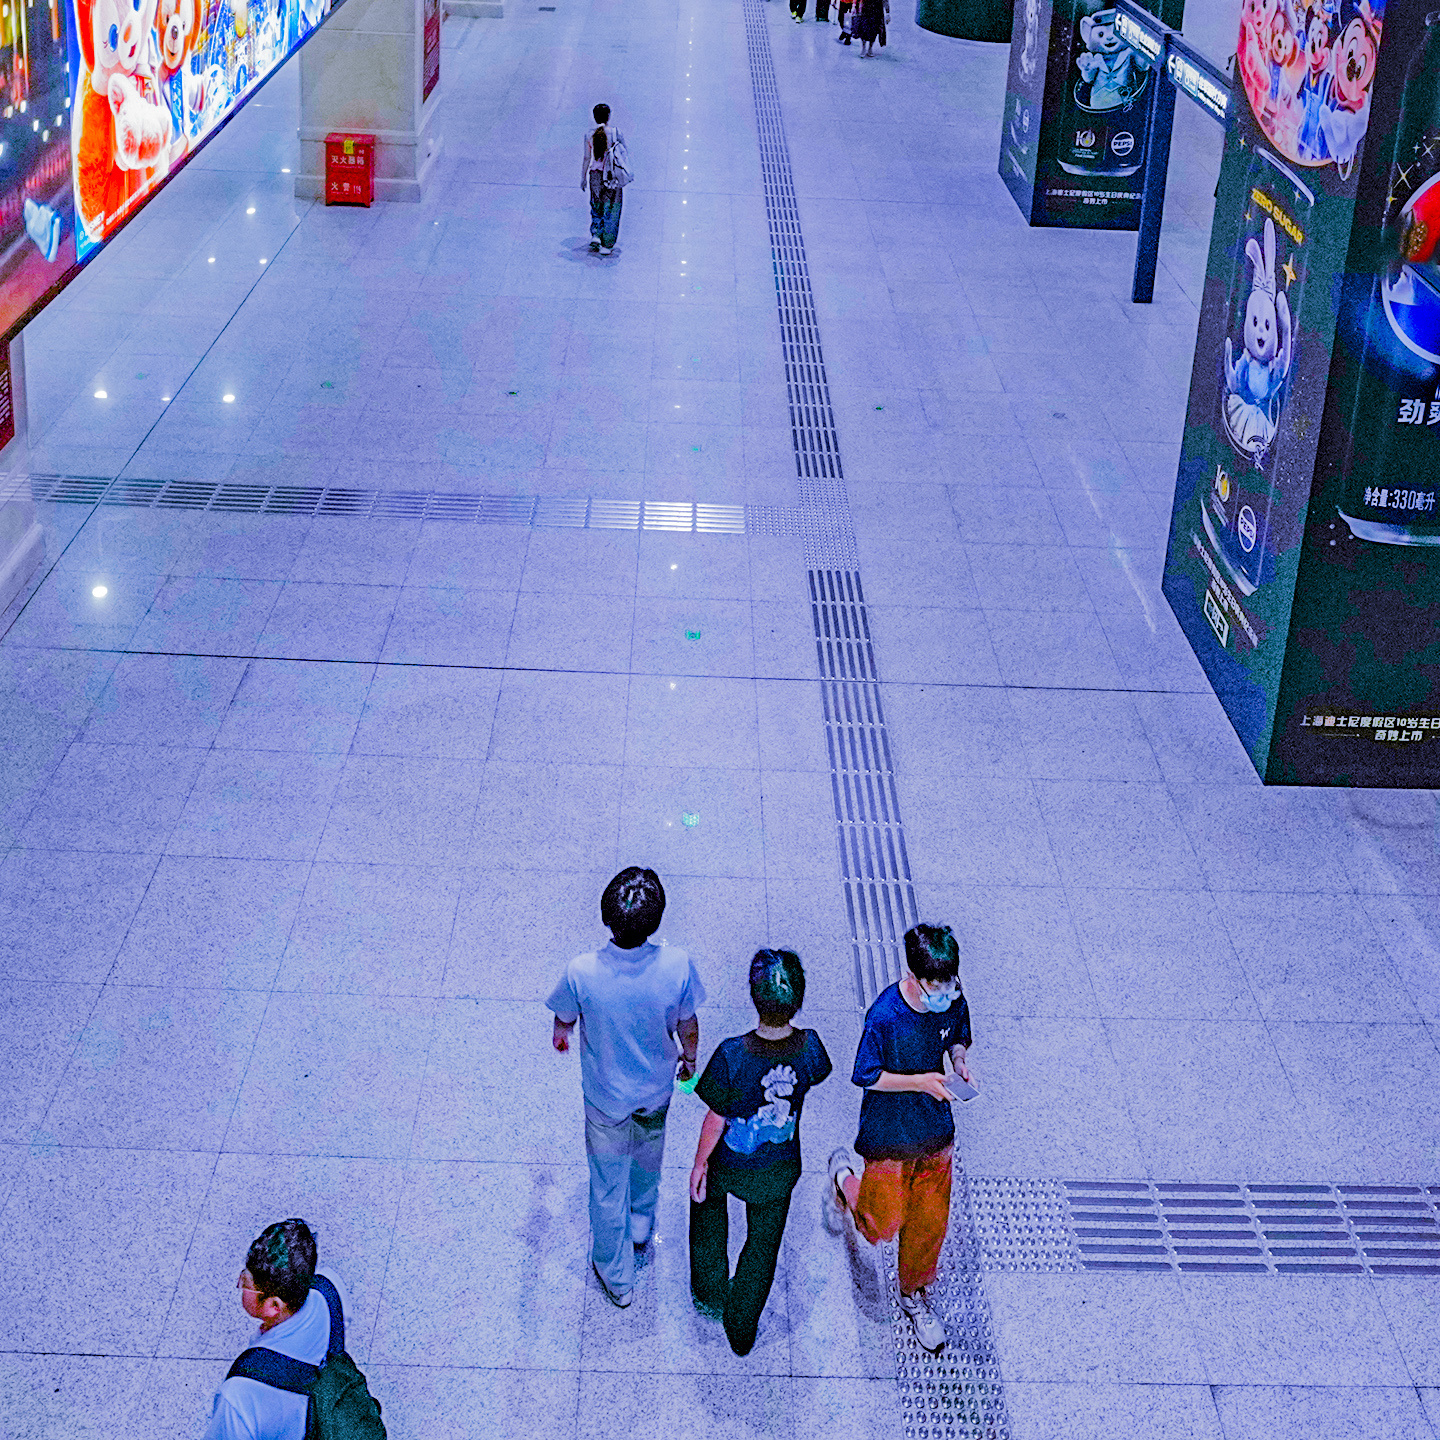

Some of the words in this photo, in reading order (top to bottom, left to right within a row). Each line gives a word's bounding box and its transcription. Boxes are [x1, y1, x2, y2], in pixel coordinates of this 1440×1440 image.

[331, 155, 364, 165] 灭火器箱
[1374, 730, 1424, 742] 奇妙上市
